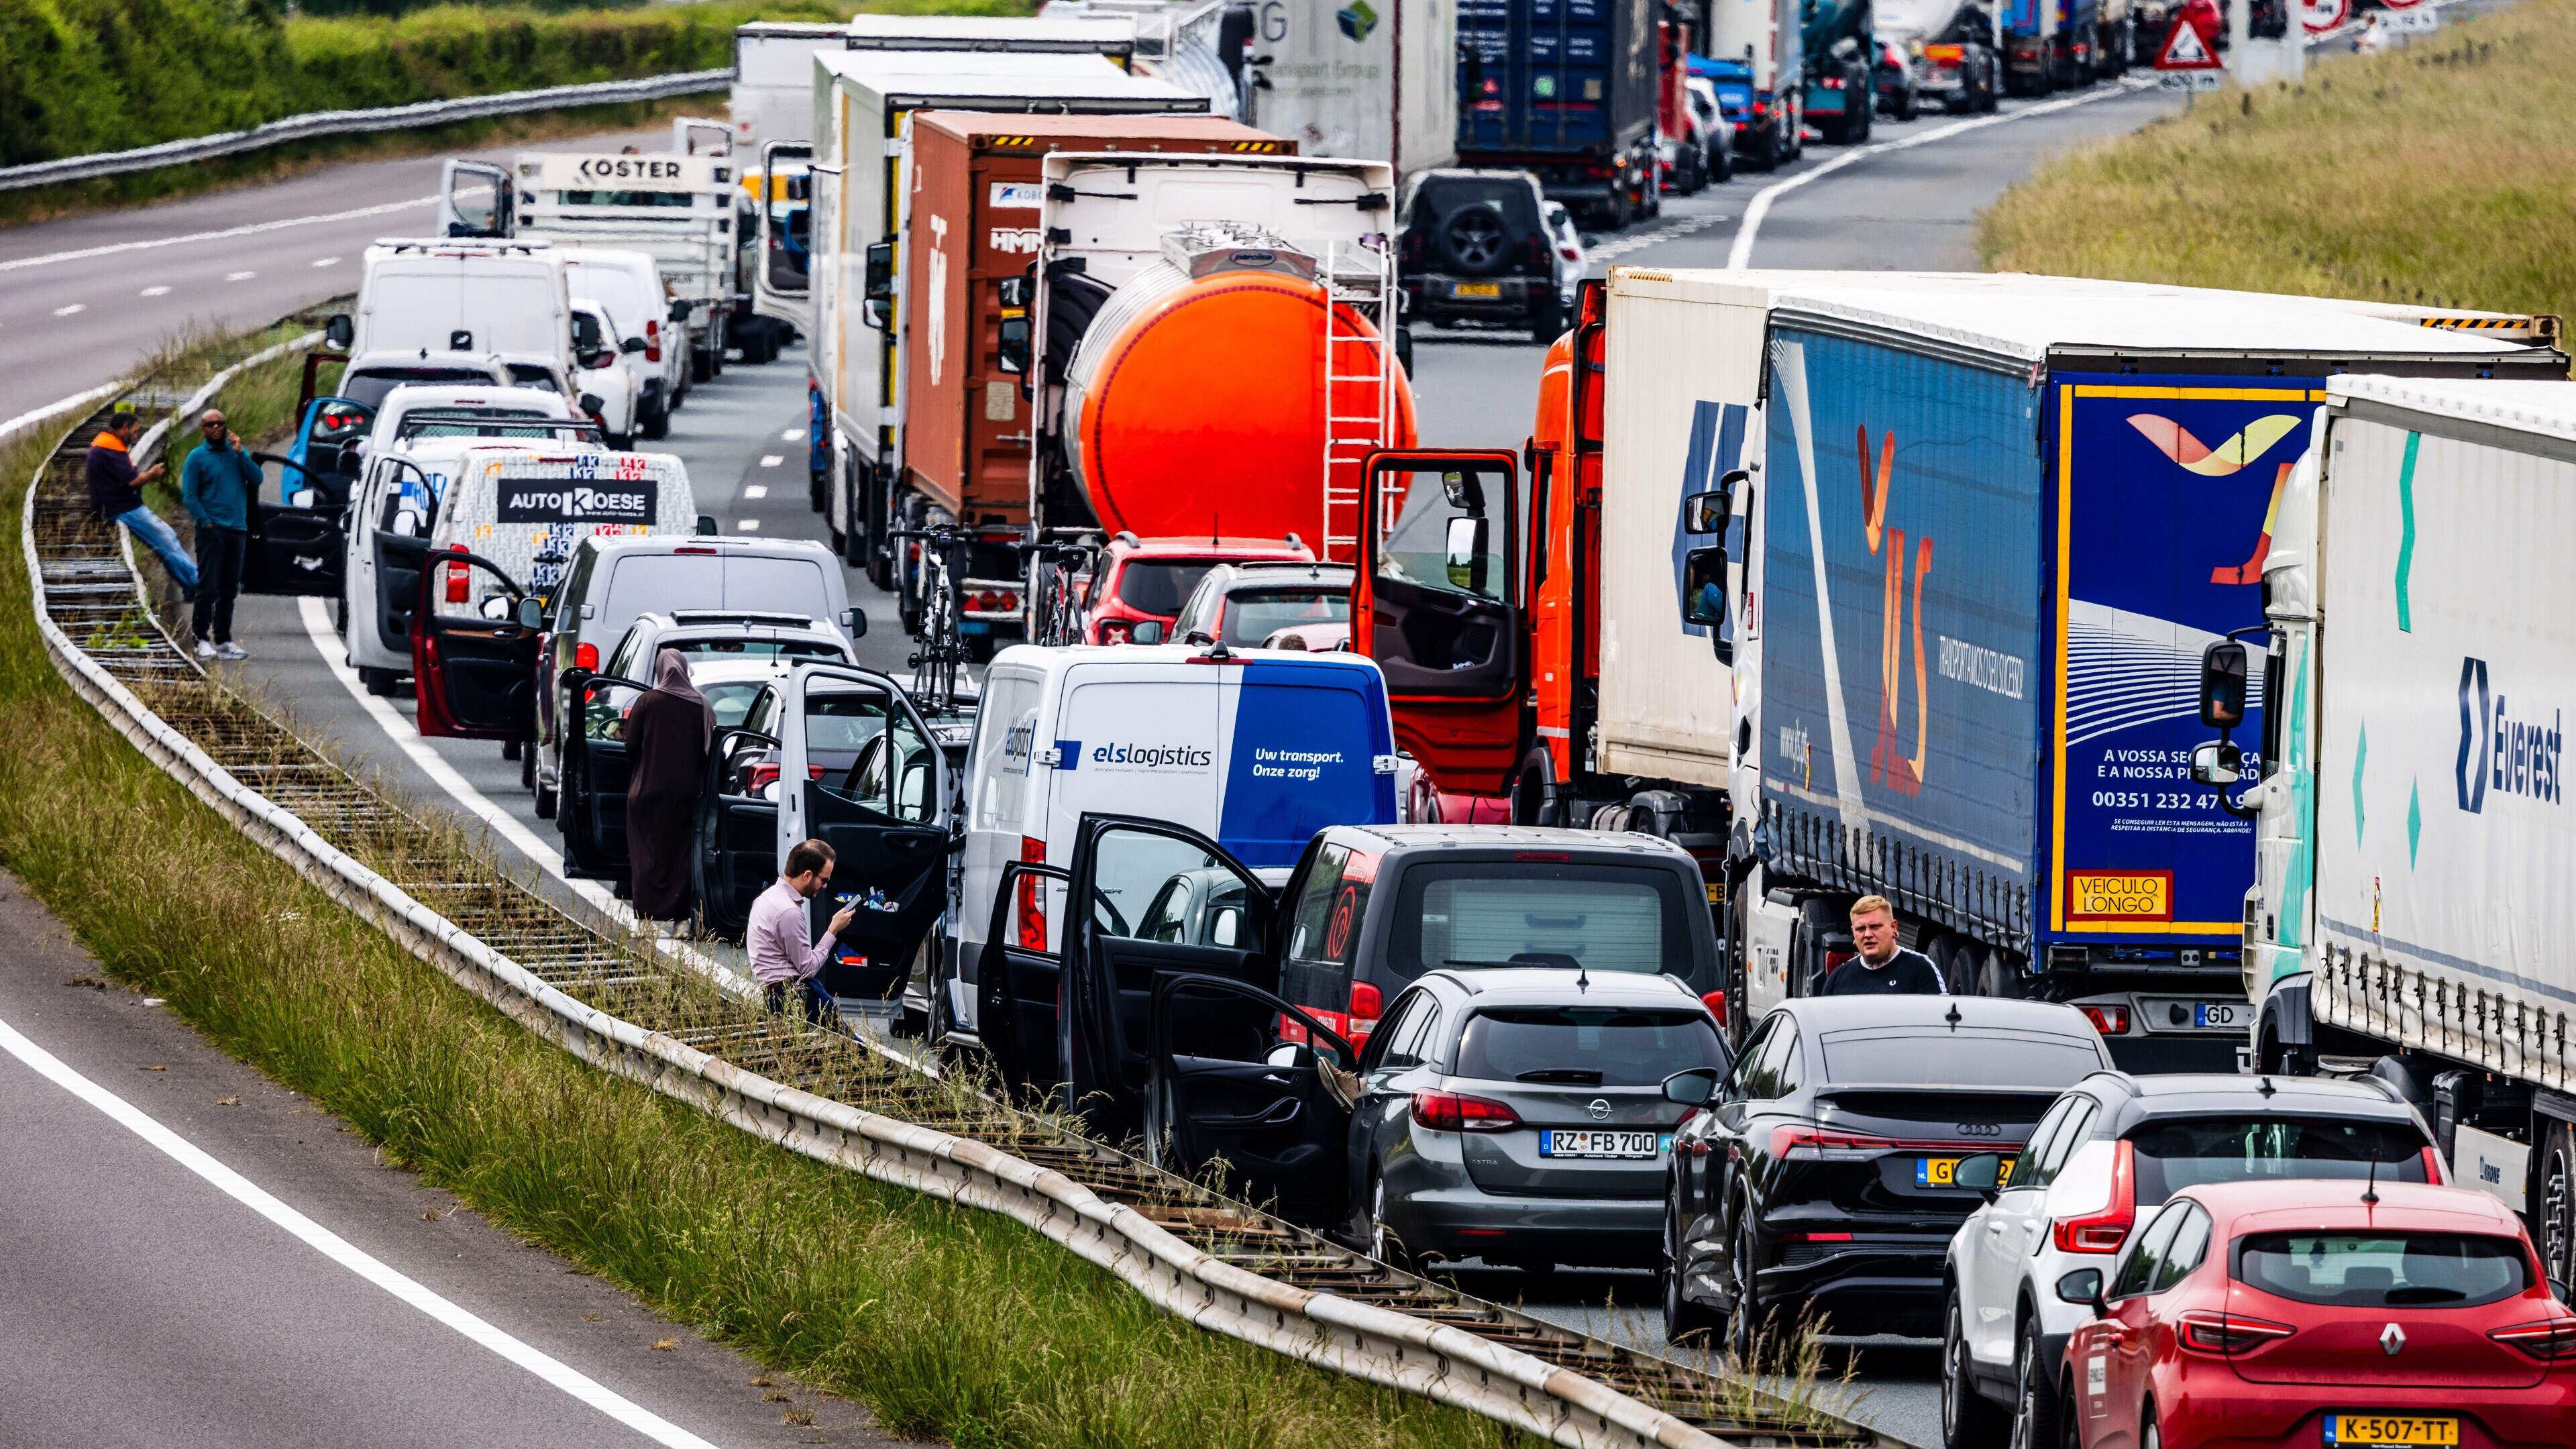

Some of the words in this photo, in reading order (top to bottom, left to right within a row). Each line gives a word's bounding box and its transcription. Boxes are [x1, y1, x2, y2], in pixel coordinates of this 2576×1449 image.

[1093, 743, 1212, 767] elslogistics
[1255, 748, 1277, 760] Uw
[1280, 750, 1344, 765] transport.
[2104, 750, 2114, 761] A
[2117, 750, 2167, 763] VOSSA
[2493, 694, 2561, 805] Everest
[1252, 764, 1285, 777] Onze
[1287, 766, 1321, 781] zorg!
[2098, 765, 2106, 777] E
[2109, 766, 2120, 777] A
[2123, 767, 2174, 779] NOSSA
[2092, 792, 2149, 808] 00351
[2156, 793, 2192, 809] 232
[2080, 877, 2157, 894] VEICULO
[2084, 896, 2154, 912] LONGO
[1553, 1132, 1577, 1151] RZ
[1591, 1132, 1615, 1151] FB
[1619, 1134, 1654, 1152] 700
[2345, 1418, 2450, 1441] K-507-TT
